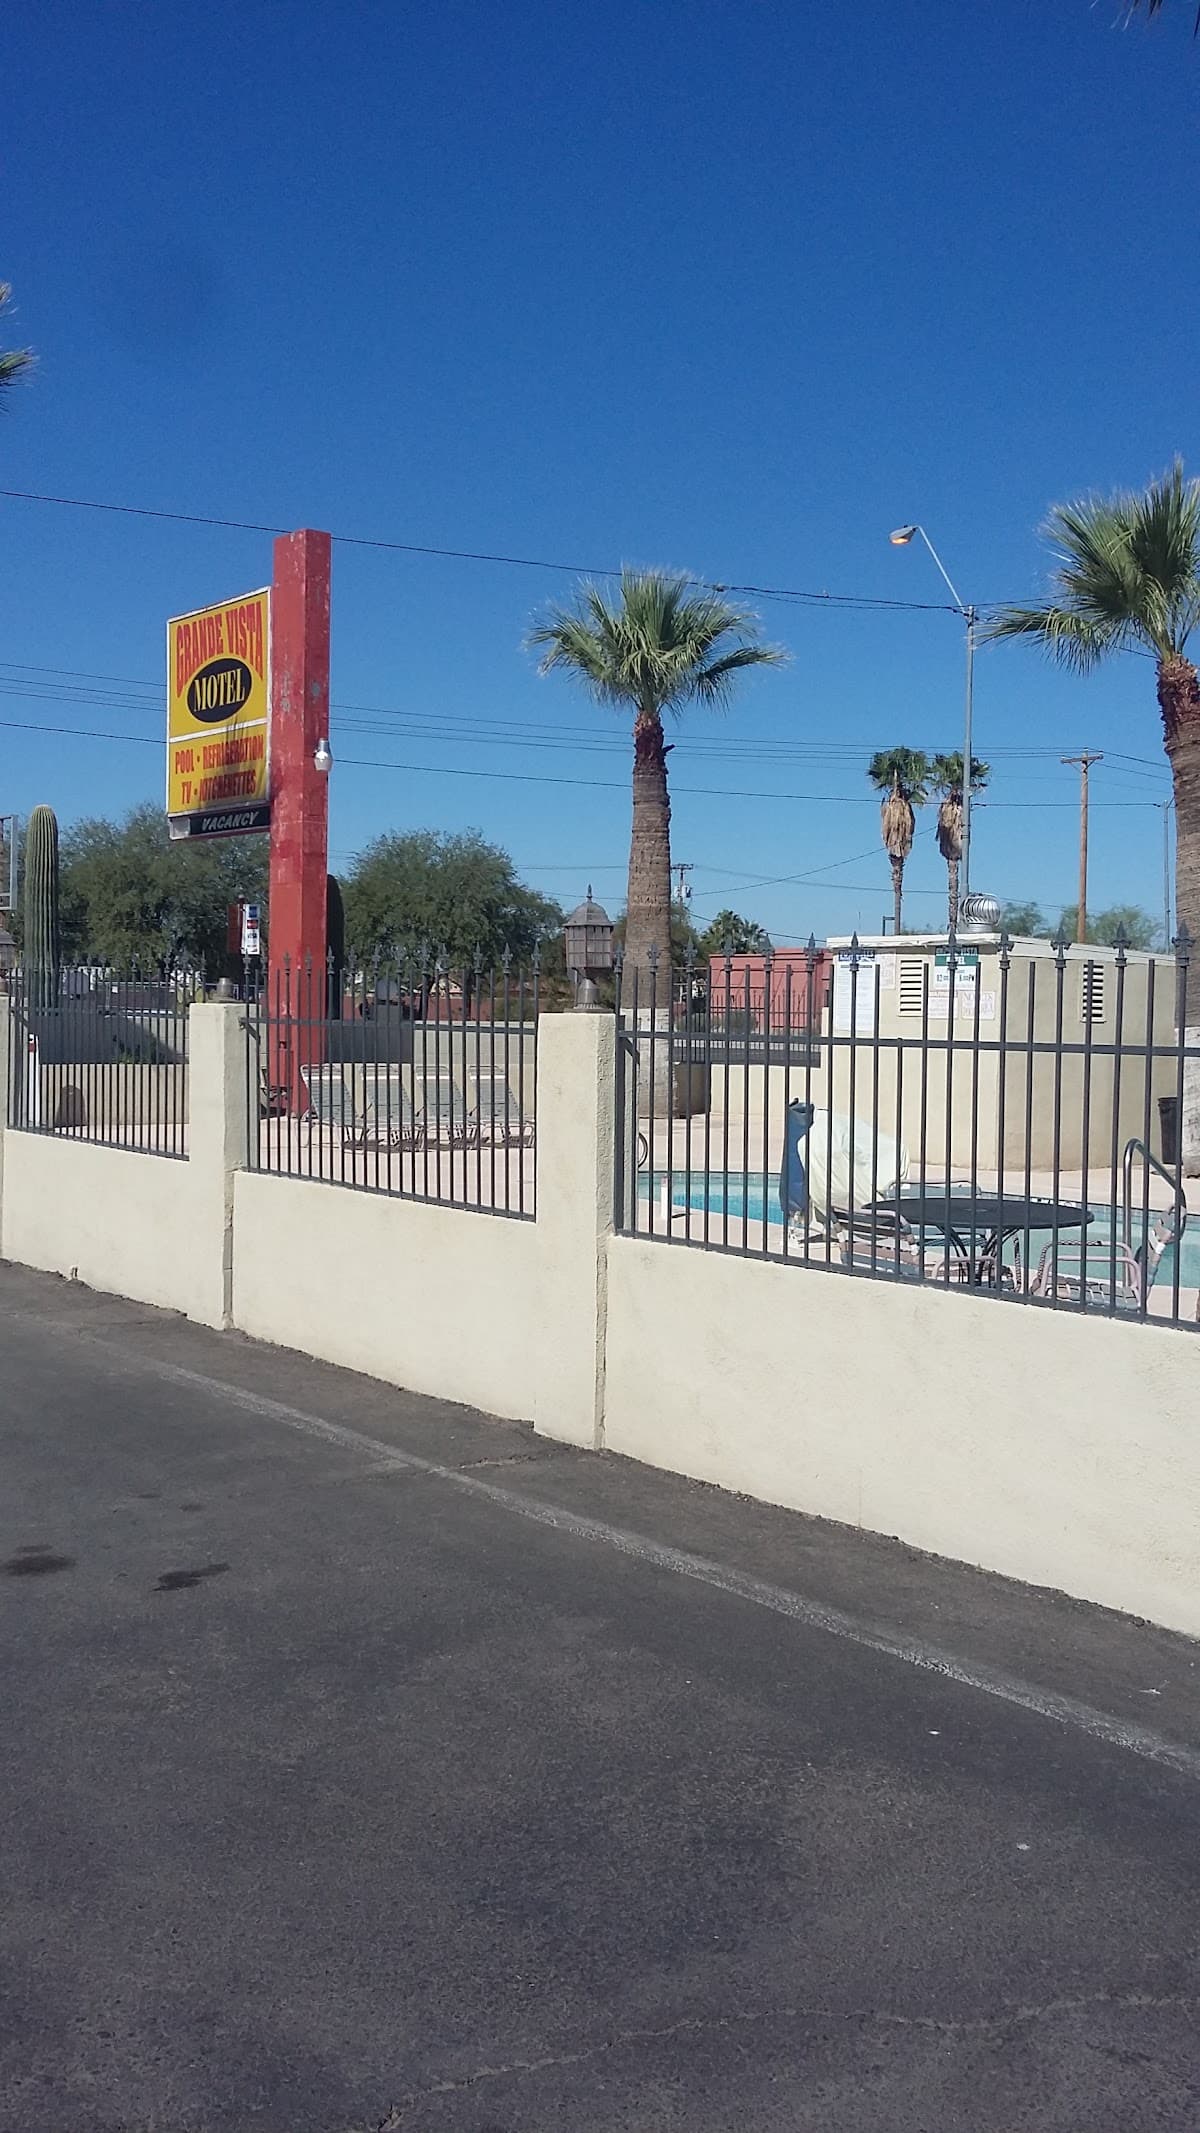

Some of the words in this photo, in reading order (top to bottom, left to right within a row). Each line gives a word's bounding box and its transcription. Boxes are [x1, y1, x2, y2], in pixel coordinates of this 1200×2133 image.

[176, 613, 224, 698] GRANDE
[226, 601, 264, 680] VISTA
[194, 668, 246, 712] MOTEL
[175, 749, 195, 774] POOL
[203, 735, 264, 769] REFRIGERATION
[181, 781, 192, 804] TV
[200, 769, 257, 801] KITCHENETTES
[202, 811, 259, 831] VACANCY
